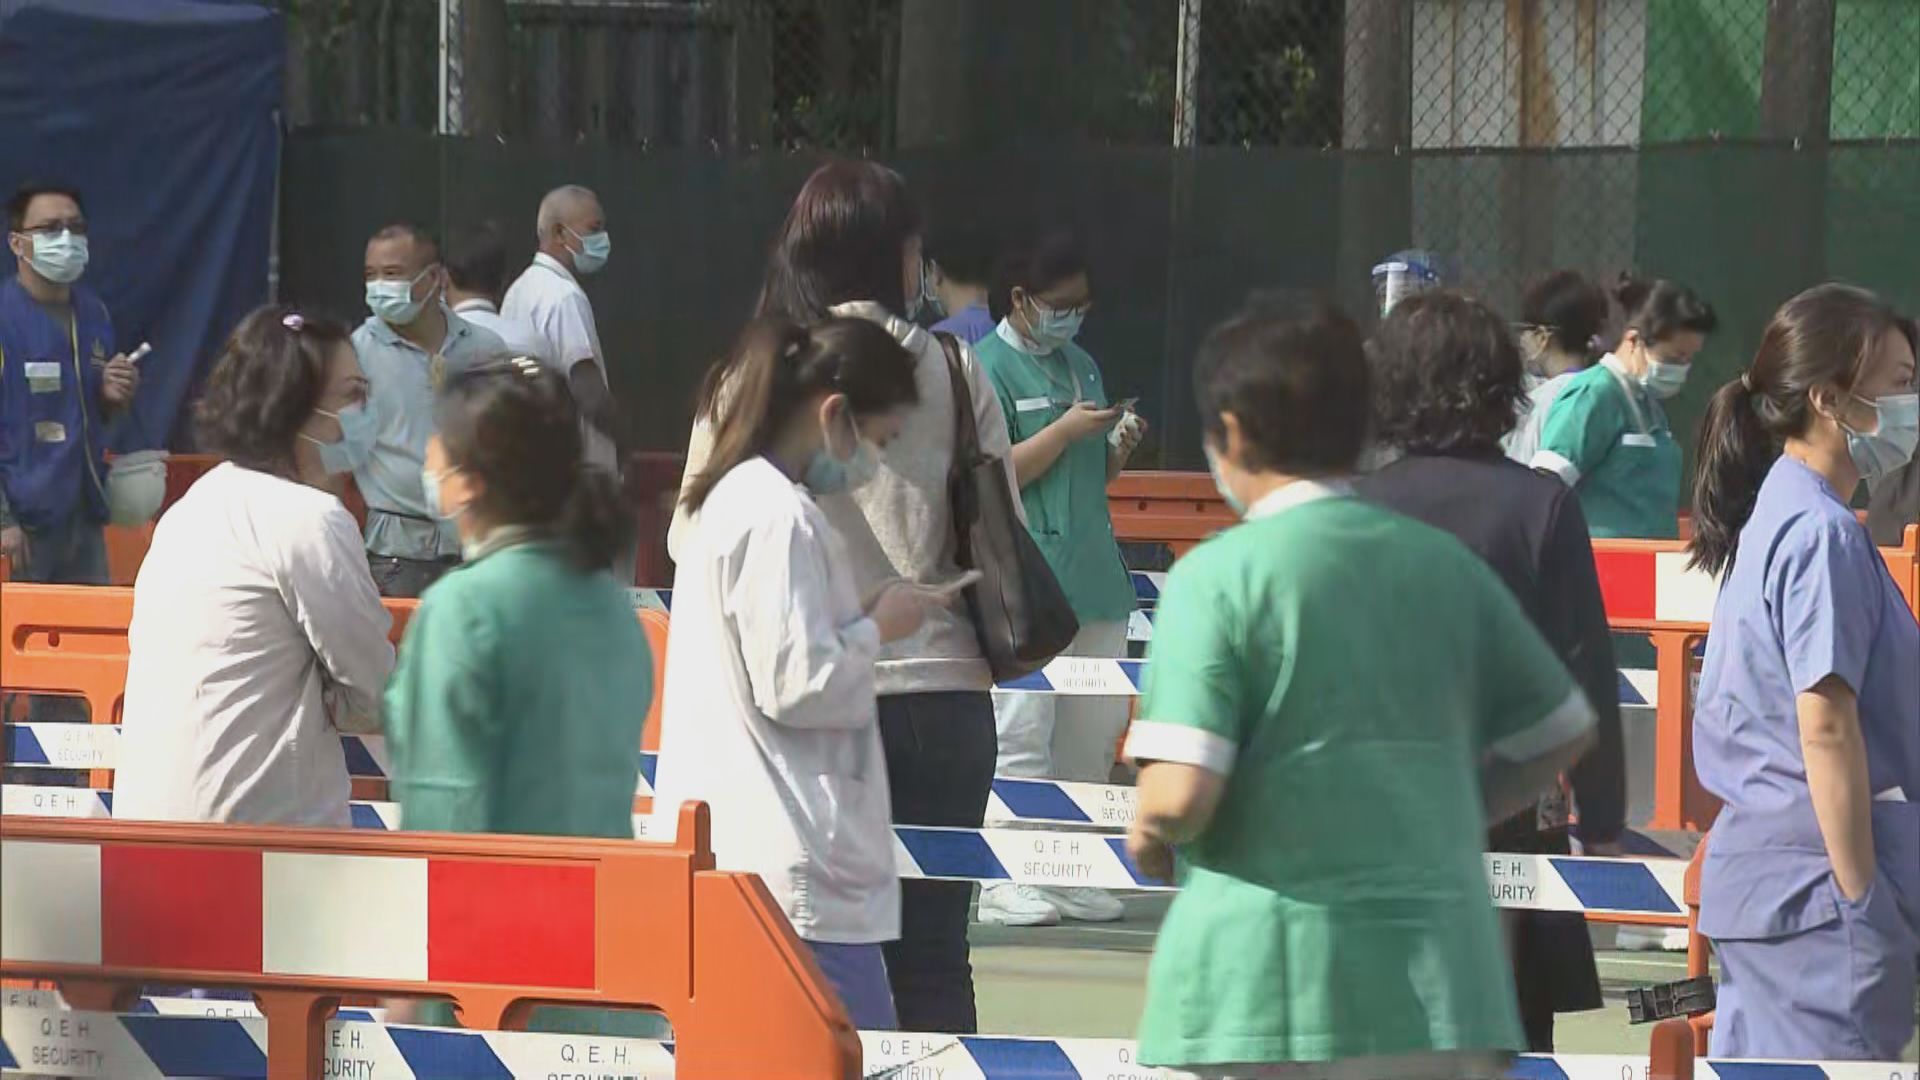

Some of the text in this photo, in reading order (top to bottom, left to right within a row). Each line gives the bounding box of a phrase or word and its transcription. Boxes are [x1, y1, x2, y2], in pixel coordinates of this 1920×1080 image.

[1023, 861, 1093, 879] SECURITY
[1490, 884, 1537, 902] URITY
[31, 1045, 105, 1073] SECURITY
[322, 1057, 376, 1078] CURITY
